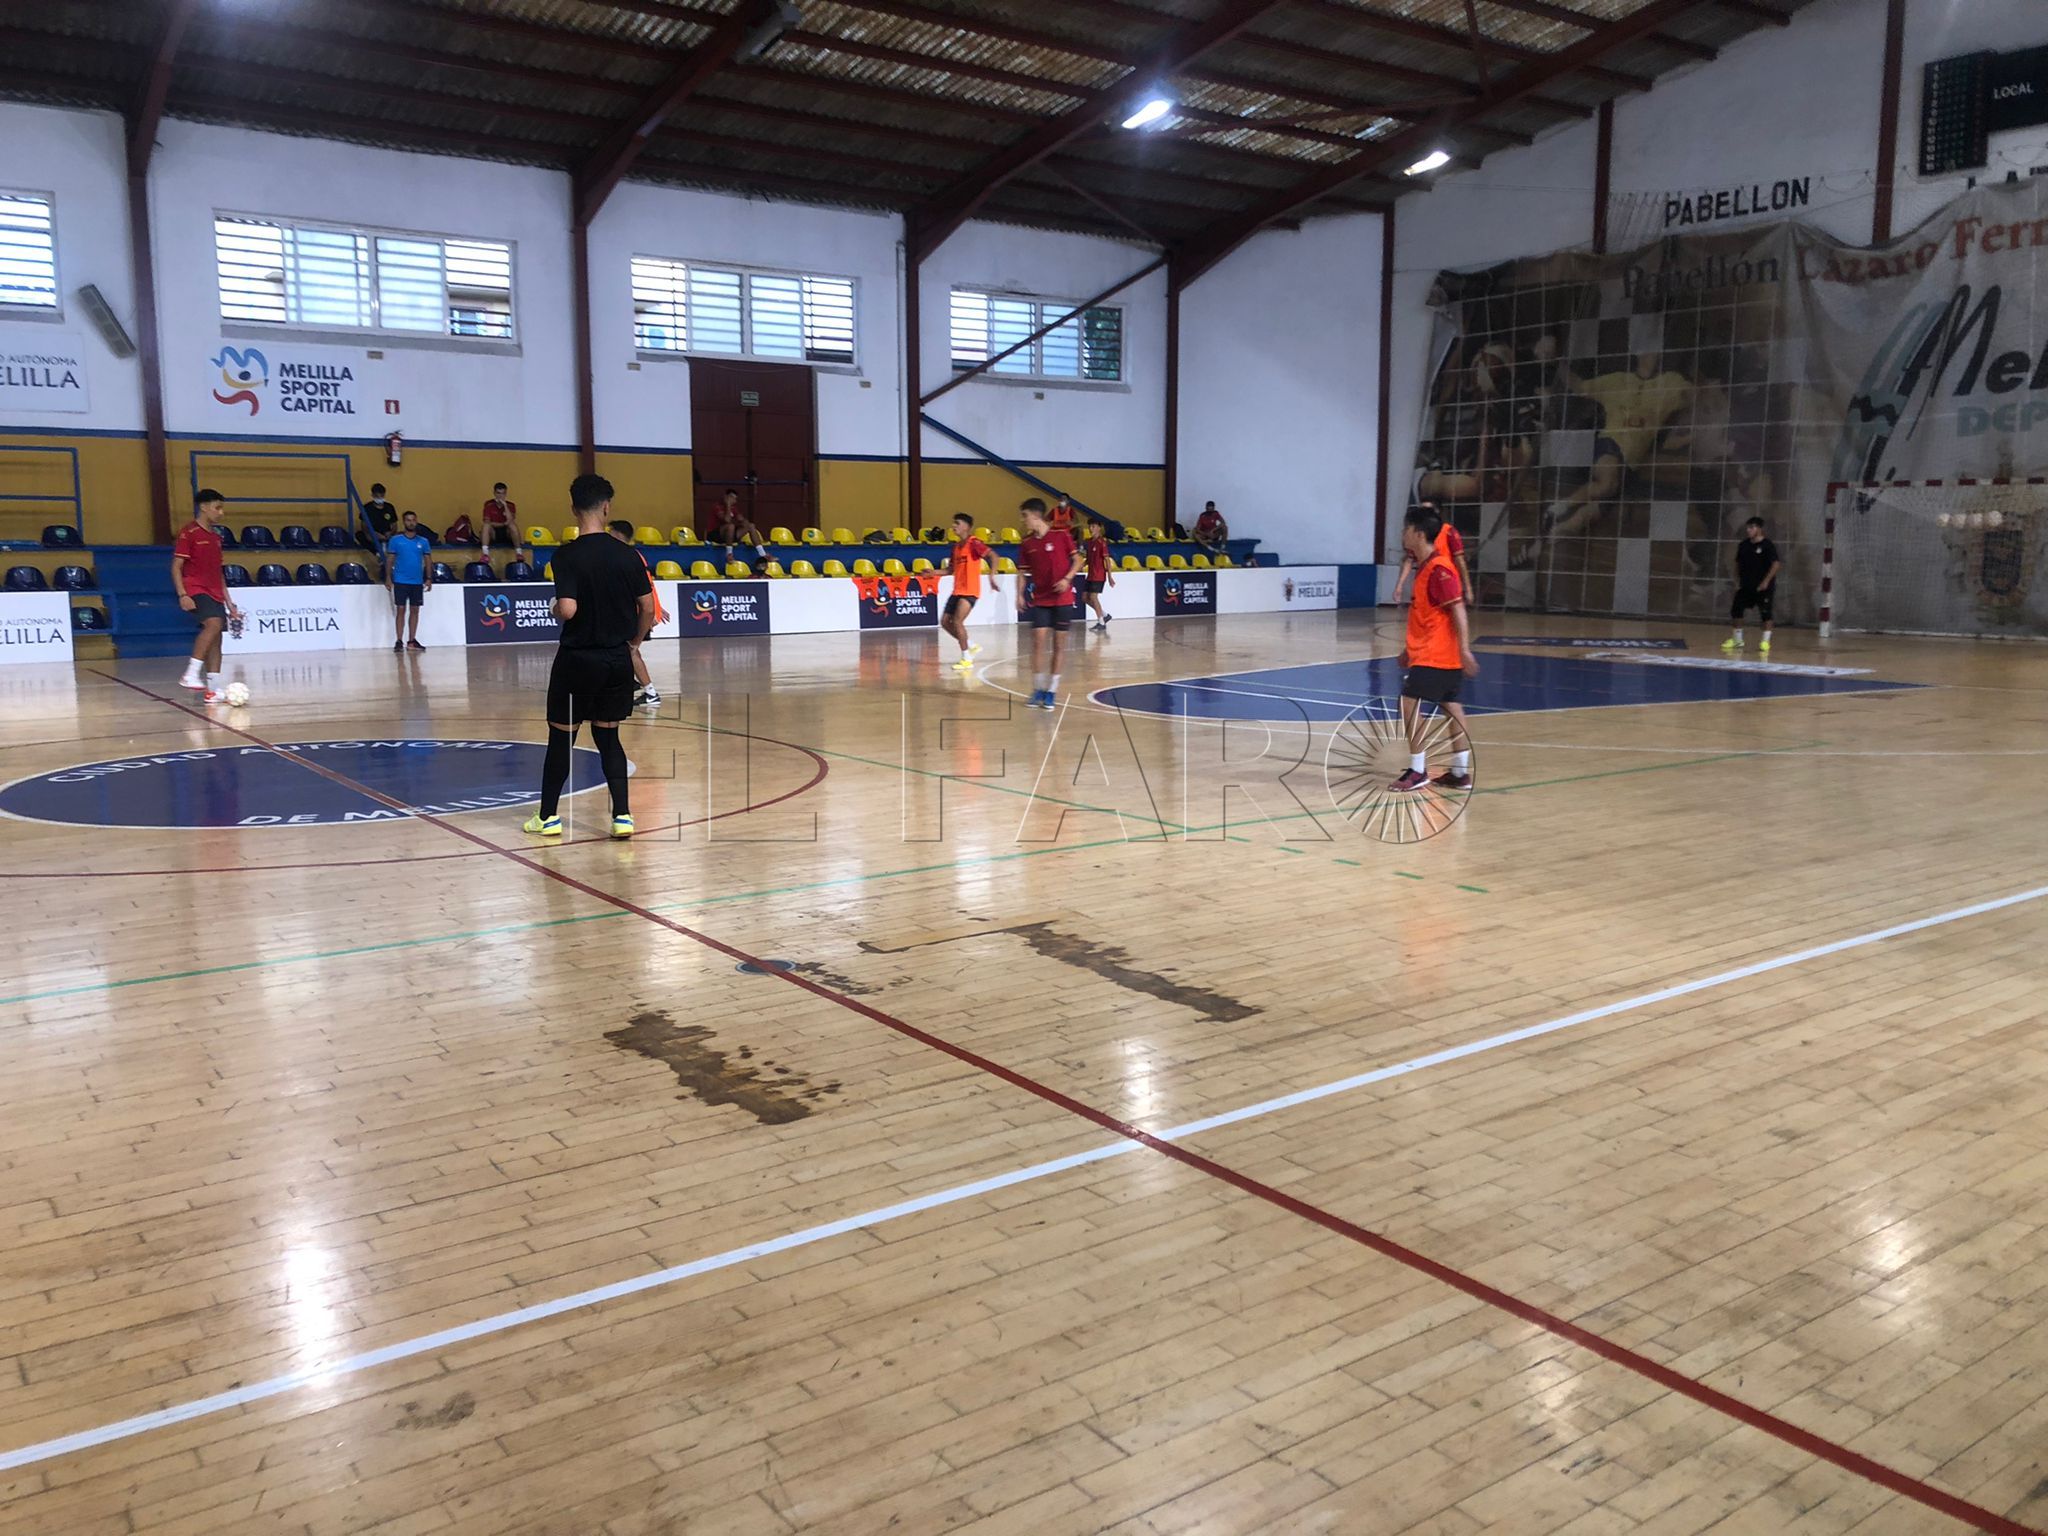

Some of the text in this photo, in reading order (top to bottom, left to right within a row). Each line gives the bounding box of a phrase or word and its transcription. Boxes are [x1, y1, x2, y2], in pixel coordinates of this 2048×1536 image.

[1993, 81, 2035, 99] LOCAL
[1665, 177, 1810, 227] PABELLON
[279, 363, 354, 381] MELILLA
[280, 380, 341, 397] SPORT
[280, 397, 356, 414] CAPITAL
[515, 600, 551, 609] MELILL
[721, 595, 757, 604] MELILLA
[896, 599, 922, 607] SPORT
[516, 609, 550, 618] SPORT
[721, 604, 751, 612] SPORT
[896, 606, 928, 615] CAPITAL
[516, 618, 558, 627] CAPITAL
[721, 612, 758, 621] CAPITAL
[258, 617, 340, 633] MELILLA
[48, 752, 217, 782] CIUDAD
[237, 790, 543, 824] DE MELILLA
